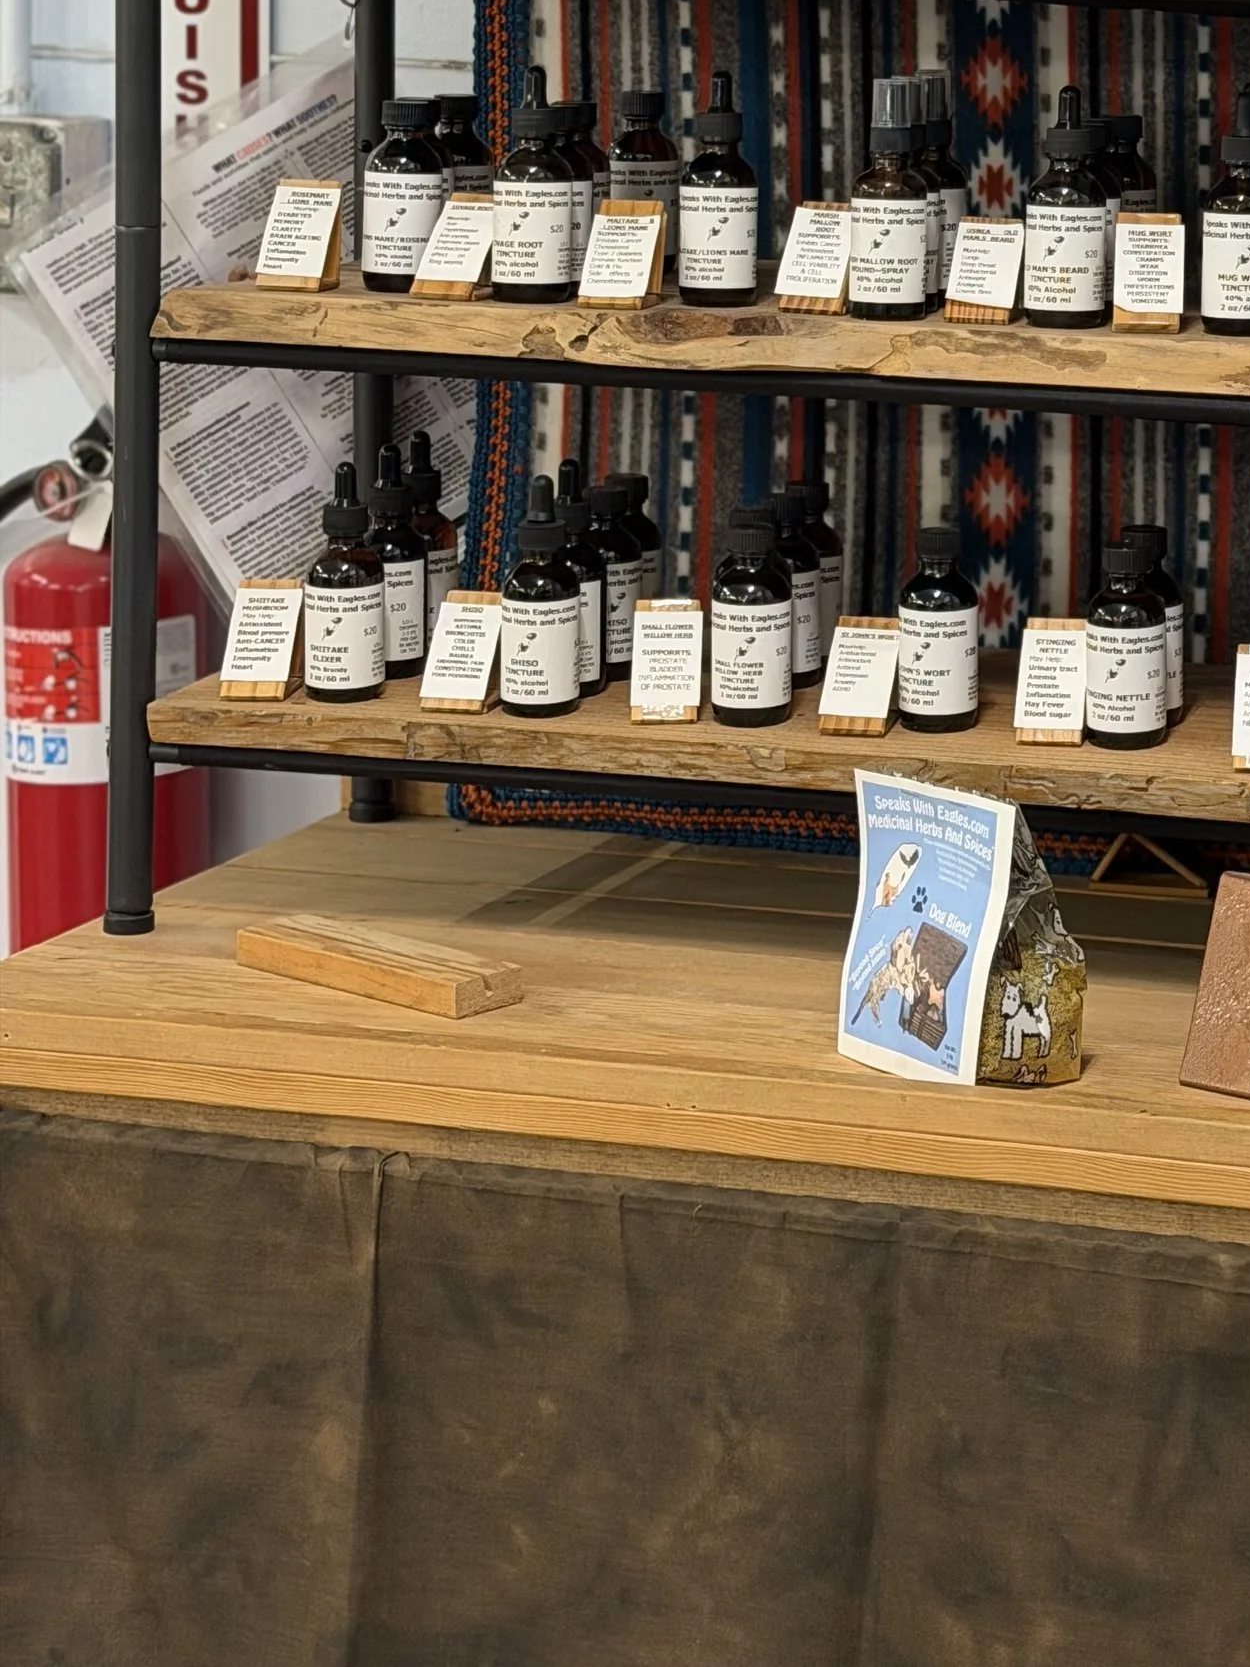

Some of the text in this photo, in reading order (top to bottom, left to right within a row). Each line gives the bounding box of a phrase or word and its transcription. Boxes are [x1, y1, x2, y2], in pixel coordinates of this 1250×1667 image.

[212, 154, 237, 174] WHAT
[273, 120, 297, 138] WHAT
[299, 94, 337, 122] SOOTHES?
[550, 225, 563, 233] $20
[1085, 249, 1098, 258] $20
[1218, 274, 1238, 282] MUG
[390, 603, 406, 612] $20
[797, 614, 811, 624] $20
[364, 626, 377, 636] $20
[776, 646, 787, 656] $20
[510, 659, 539, 667] SHISO
[1029, 665, 1057, 673] Urinary
[1147, 669, 1160, 679] $20
[1116, 693, 1150, 701] NETTLE
[1049, 711, 1071, 719] sugar
[874, 795, 989, 838] Speaks With Eagles.com
[868, 814, 913, 831] Medicinal
[916, 818, 943, 837] Herbs
[944, 828, 963, 846] And
[929, 903, 972, 938] Dog Blend
